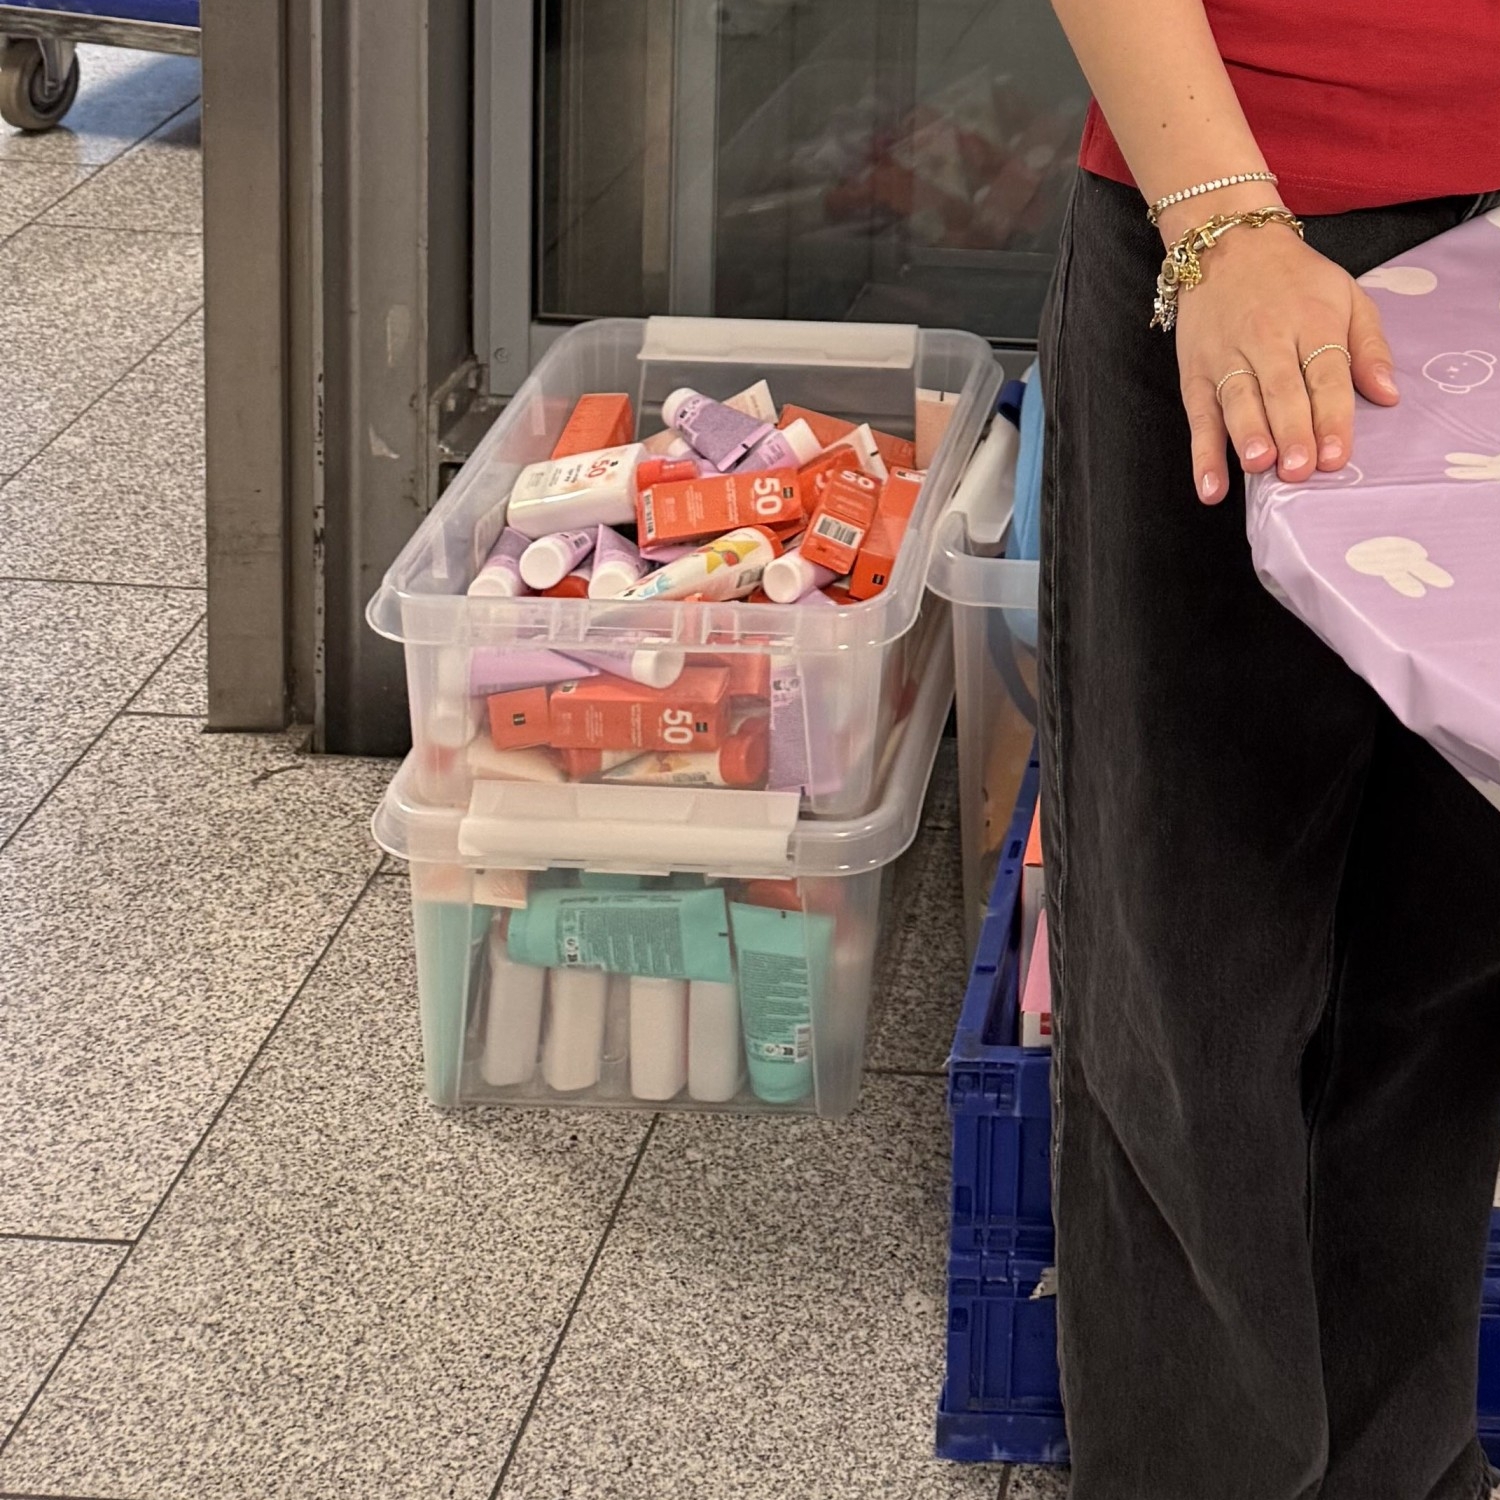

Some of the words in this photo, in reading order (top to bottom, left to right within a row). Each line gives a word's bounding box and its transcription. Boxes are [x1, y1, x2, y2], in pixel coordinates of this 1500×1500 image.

[753, 477, 783, 515] 50
[840, 470, 875, 490] 50
[663, 708, 694, 745] 50
